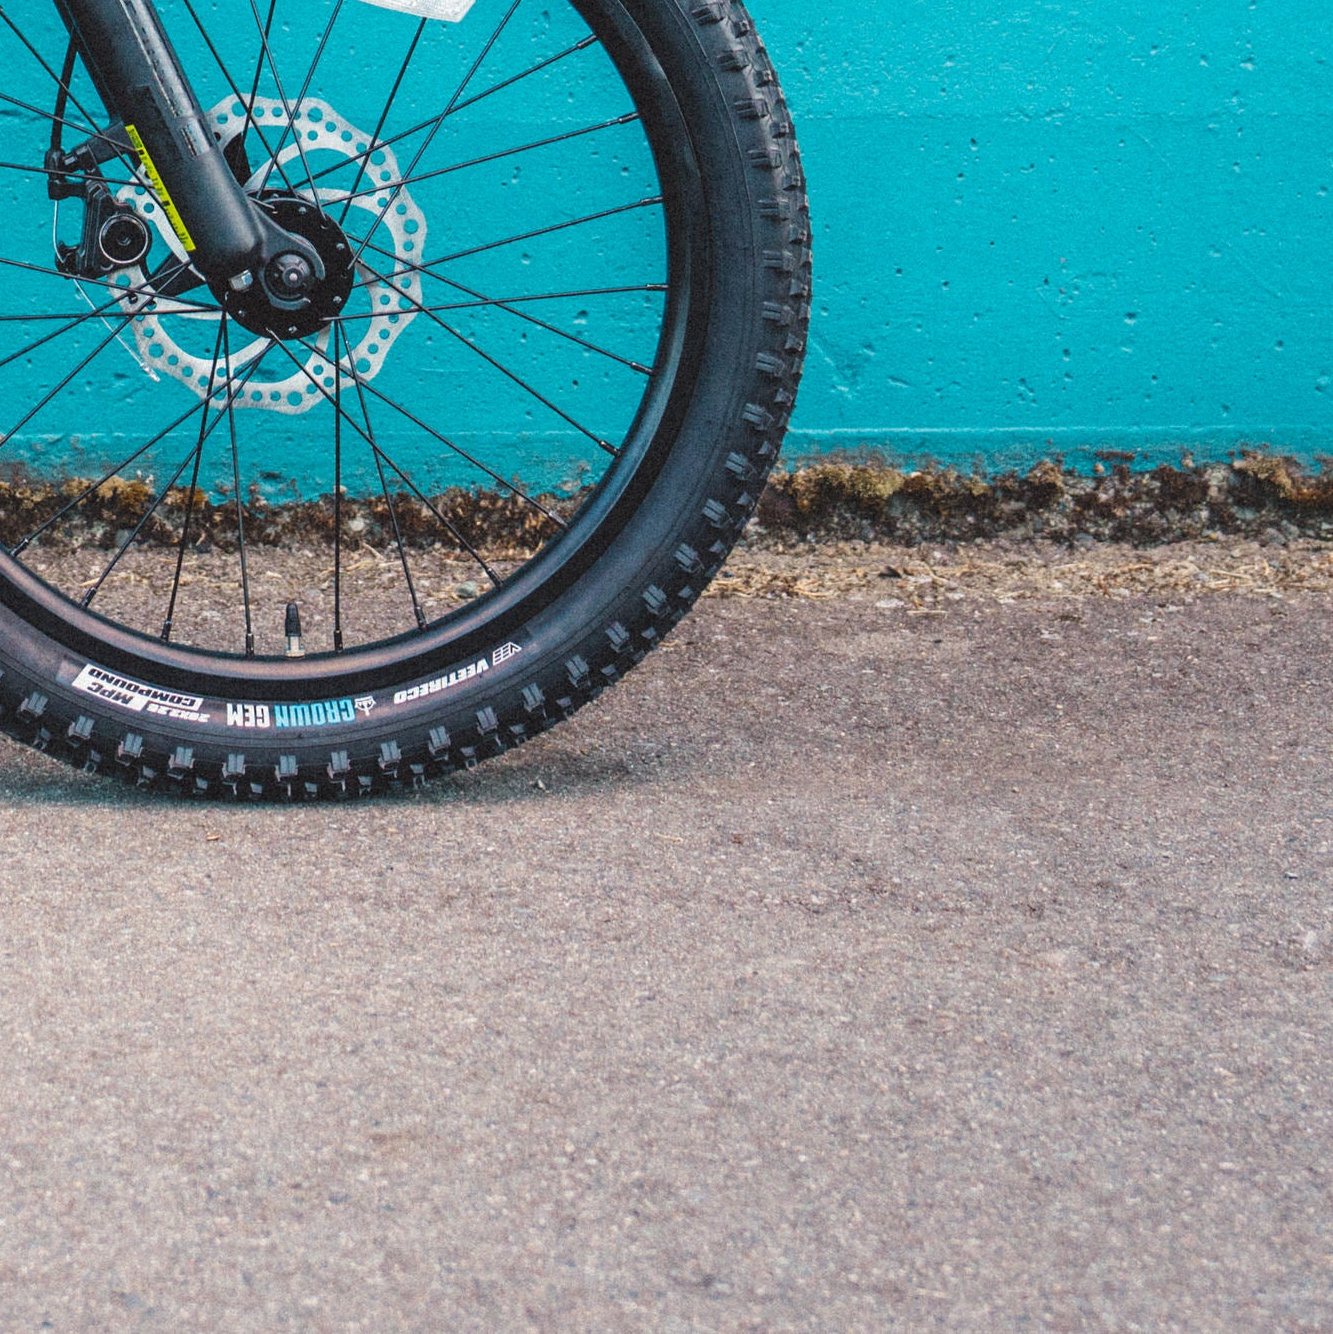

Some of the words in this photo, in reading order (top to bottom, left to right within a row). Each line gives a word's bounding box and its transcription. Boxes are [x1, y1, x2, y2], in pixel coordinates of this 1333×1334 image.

[85, 681, 134, 706] MPC
[87, 667, 197, 708] COMPOUND
[393, 658, 490, 705] VEETIRECO
[225, 702, 271, 728] GEM
[273, 697, 356, 728] CROWN
